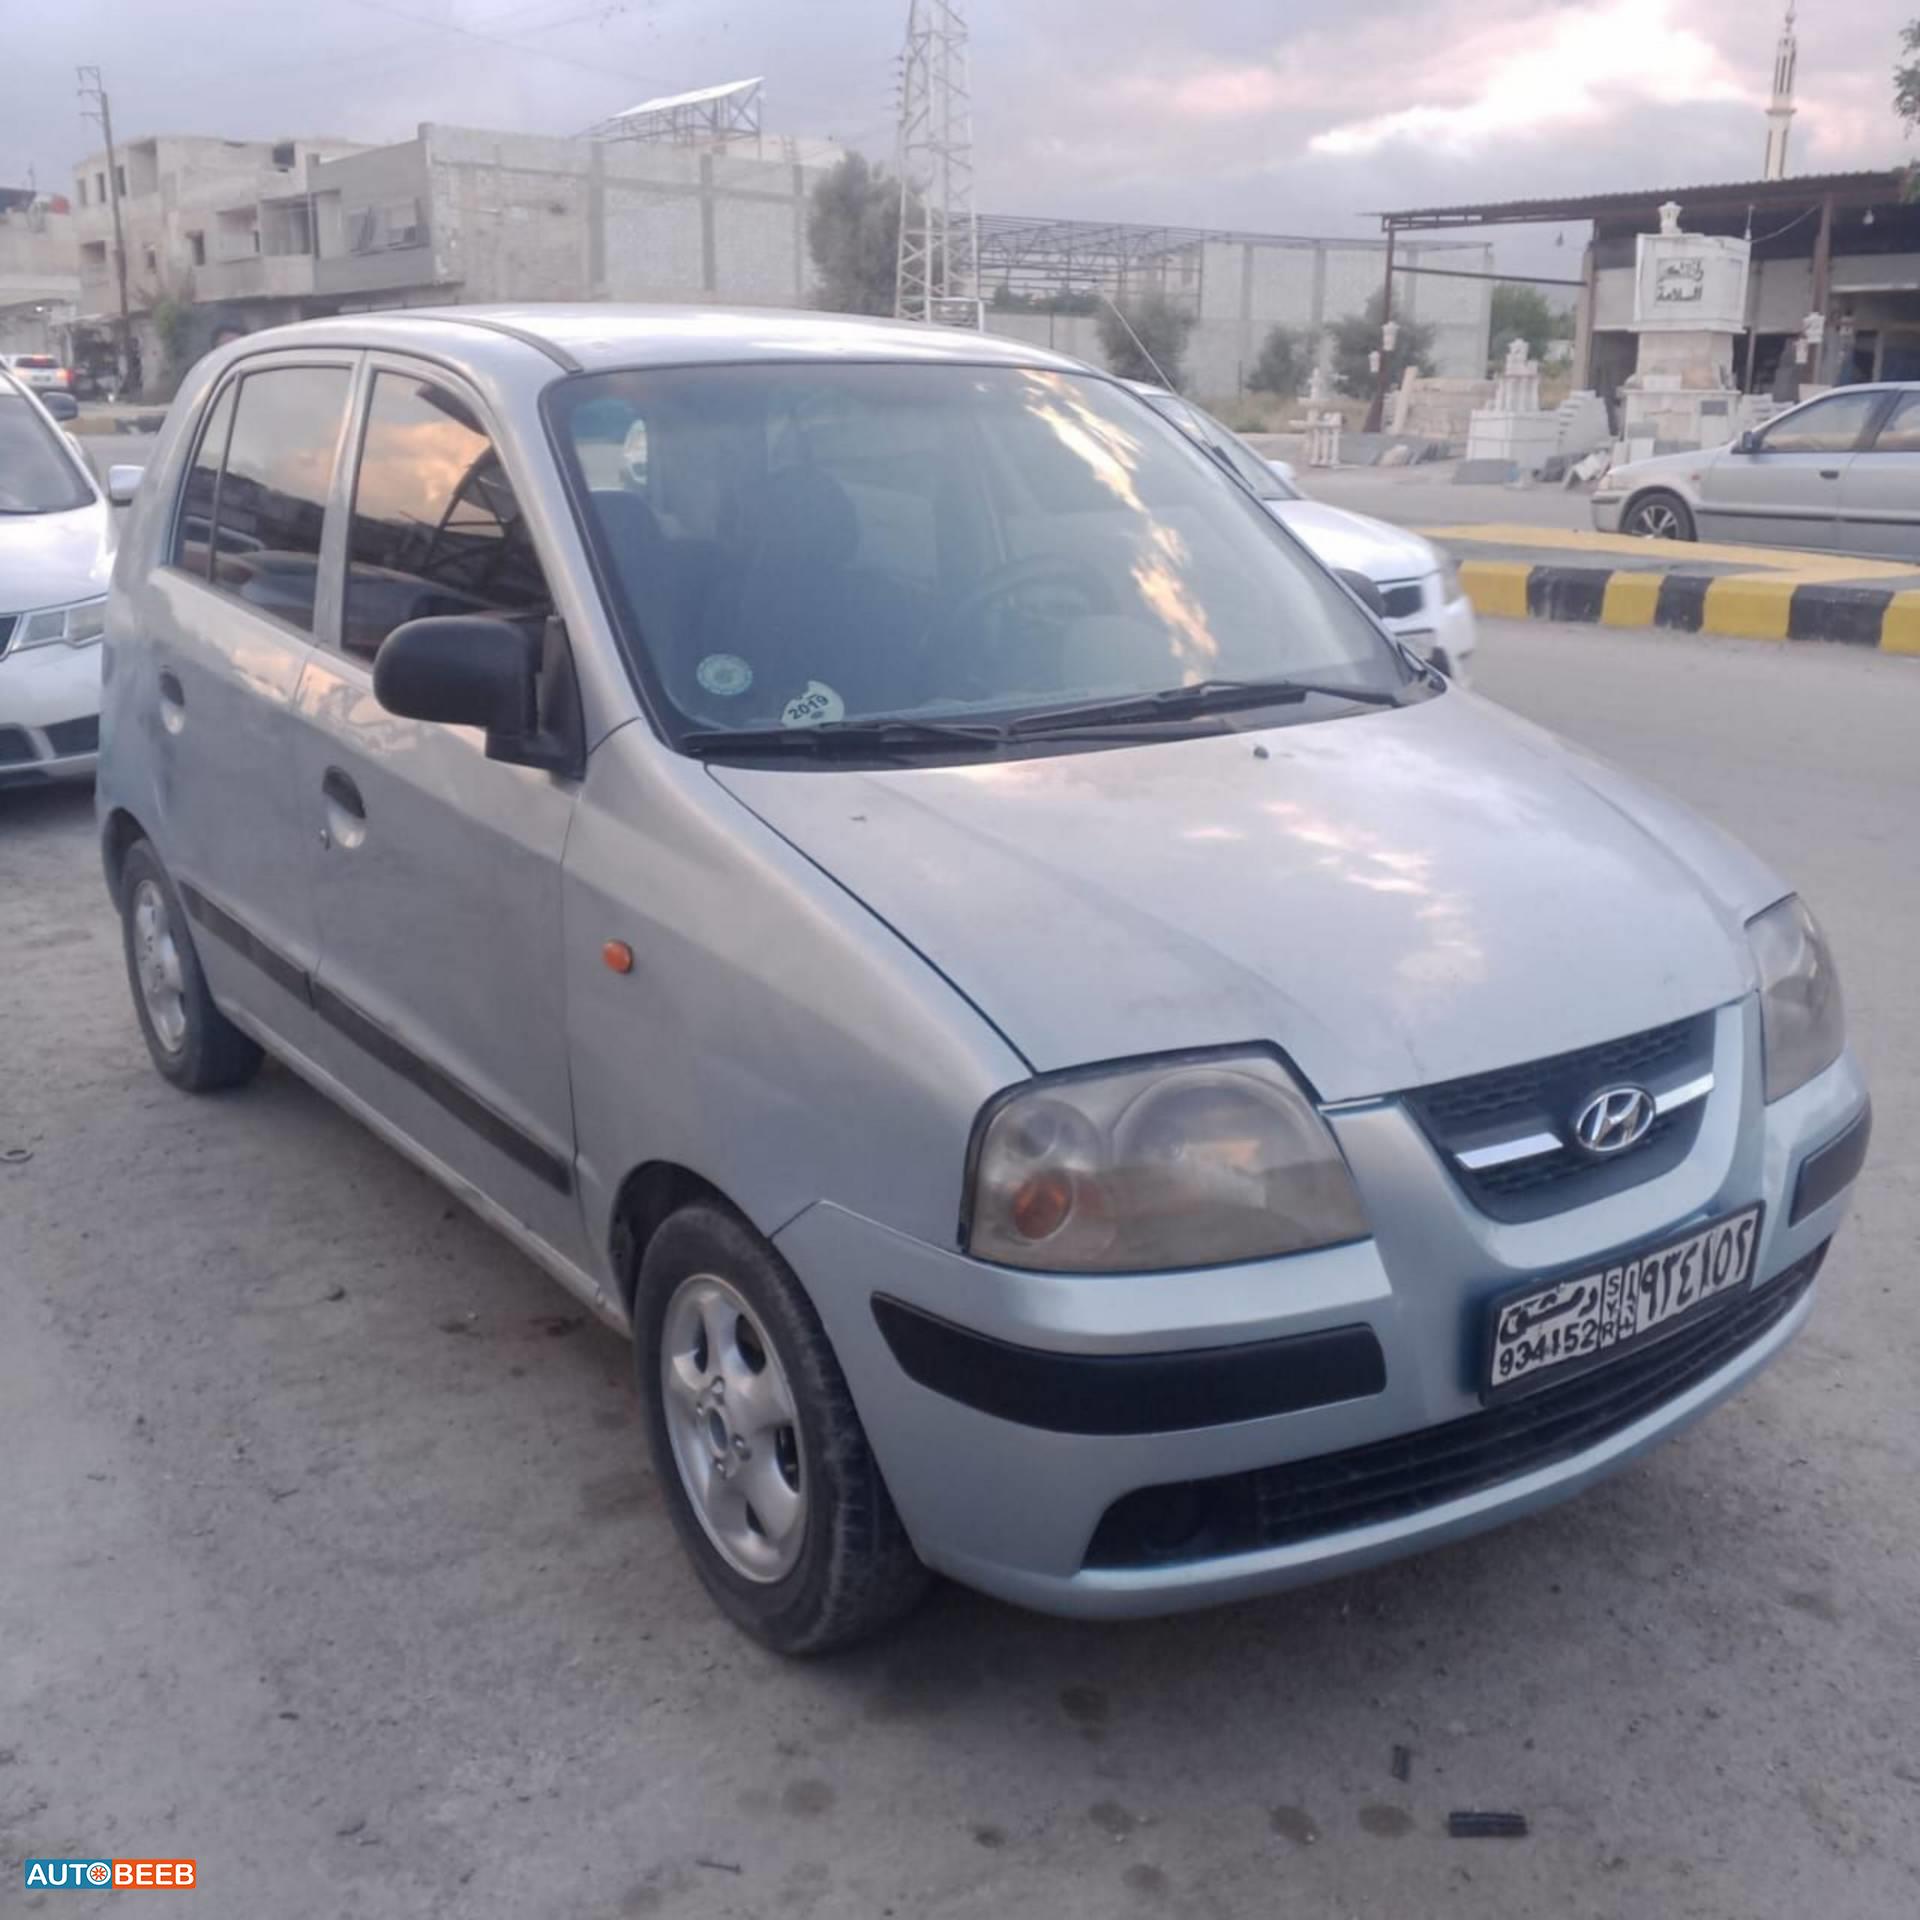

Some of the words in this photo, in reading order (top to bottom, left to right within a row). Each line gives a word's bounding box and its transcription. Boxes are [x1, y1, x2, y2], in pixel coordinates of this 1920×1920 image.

[1656, 285, 1703, 301] السلامة
[788, 694, 829, 720] 2019
[1641, 1219, 1753, 1320] ٩٣٤١٥٢
[1602, 1275, 1620, 1340] SYR
[1500, 1319, 1598, 1376] 934152
